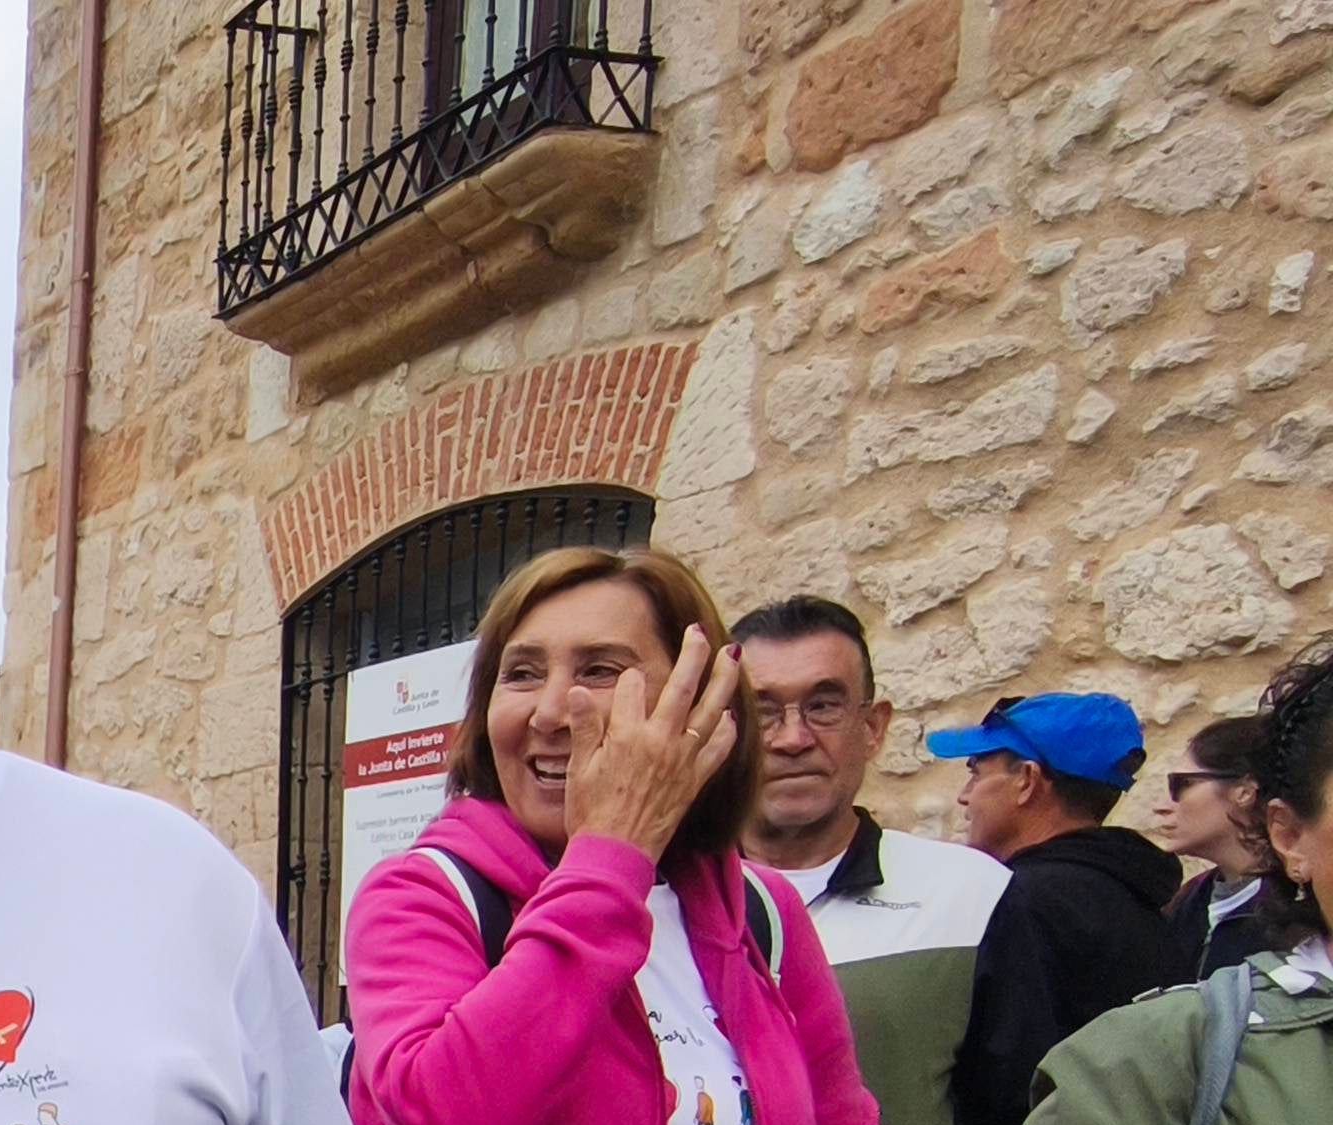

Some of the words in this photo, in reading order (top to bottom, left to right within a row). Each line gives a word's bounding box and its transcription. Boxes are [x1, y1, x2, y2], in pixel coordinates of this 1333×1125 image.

[358, 764, 367, 776] la
[368, 760, 393, 775] Junta
[394, 757, 406, 770] de
[408, 751, 441, 768] Castilla
